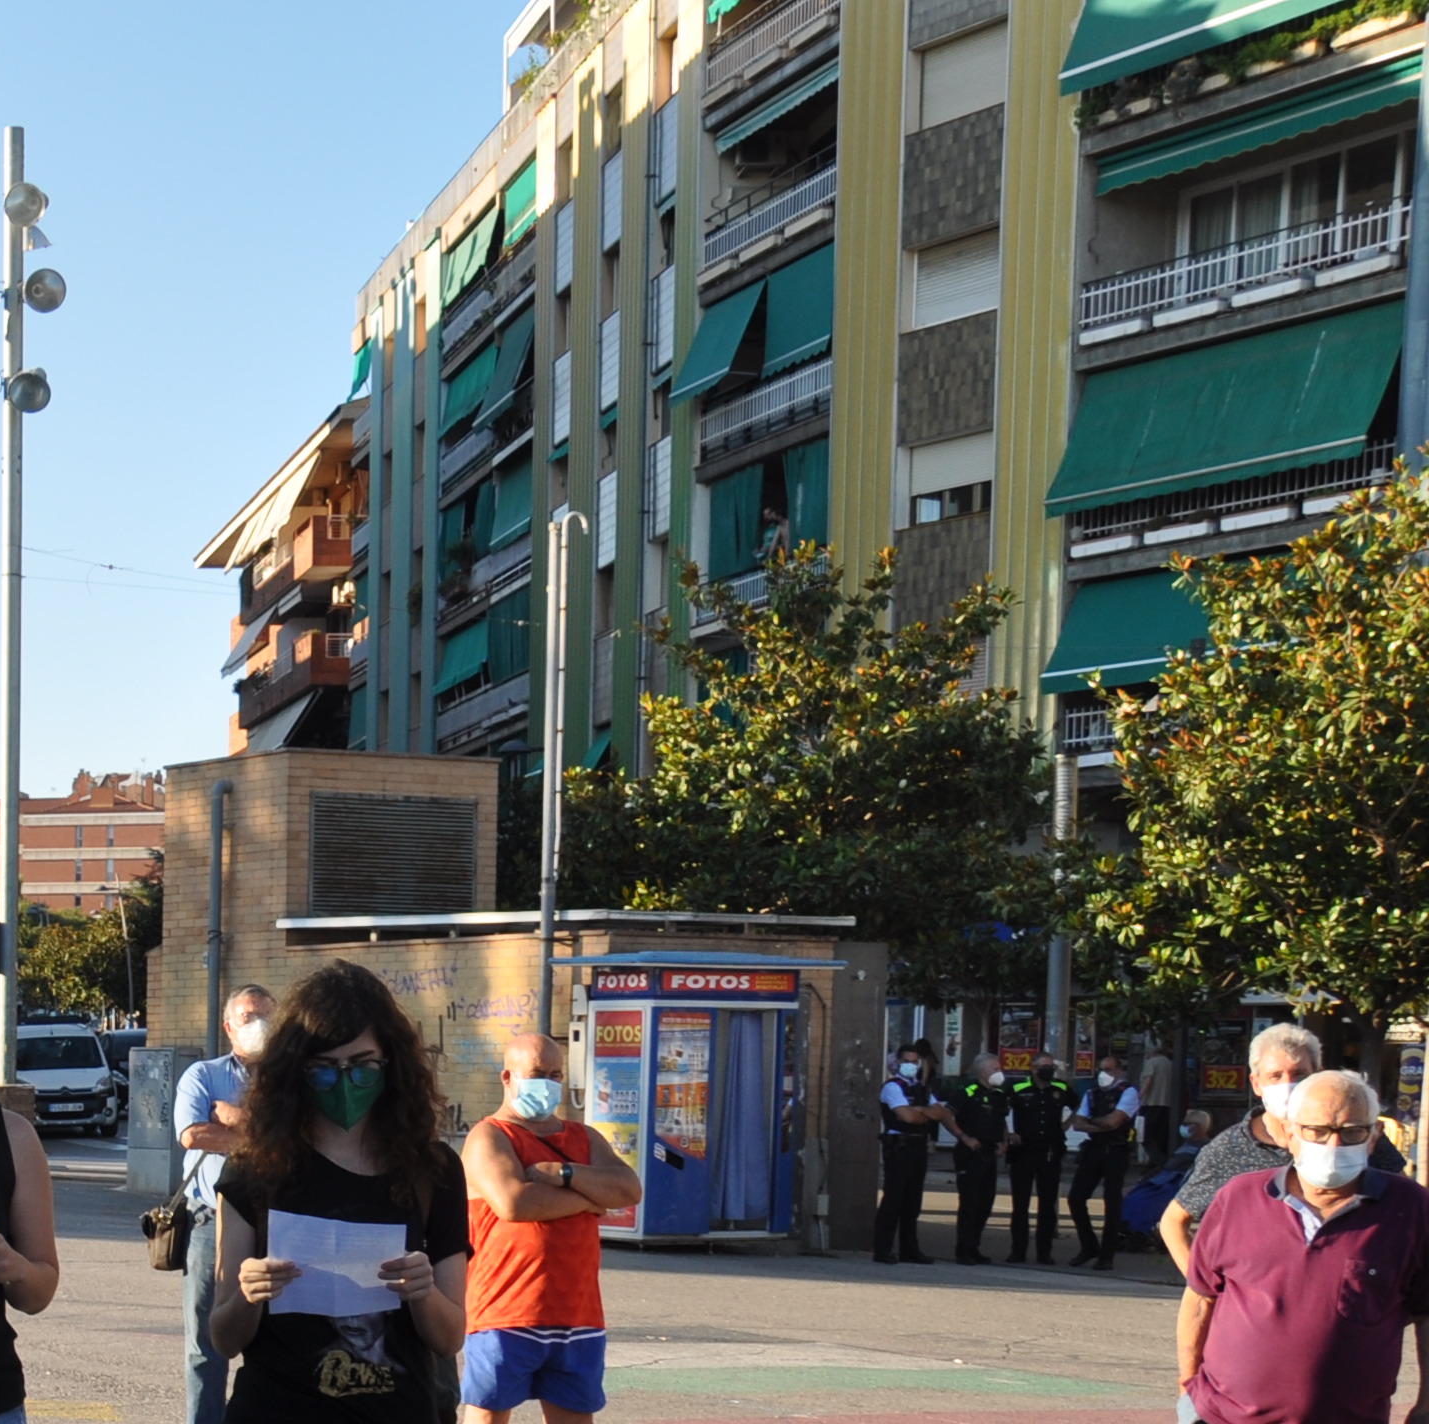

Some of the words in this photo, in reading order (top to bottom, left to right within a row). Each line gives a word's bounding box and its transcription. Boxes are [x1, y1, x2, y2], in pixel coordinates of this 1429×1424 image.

[598, 973, 648, 989] FOTOS
[671, 974, 751, 990] FOTOS
[596, 1025, 642, 1043] FOTOS
[1205, 1070, 1238, 1089] 3x2
